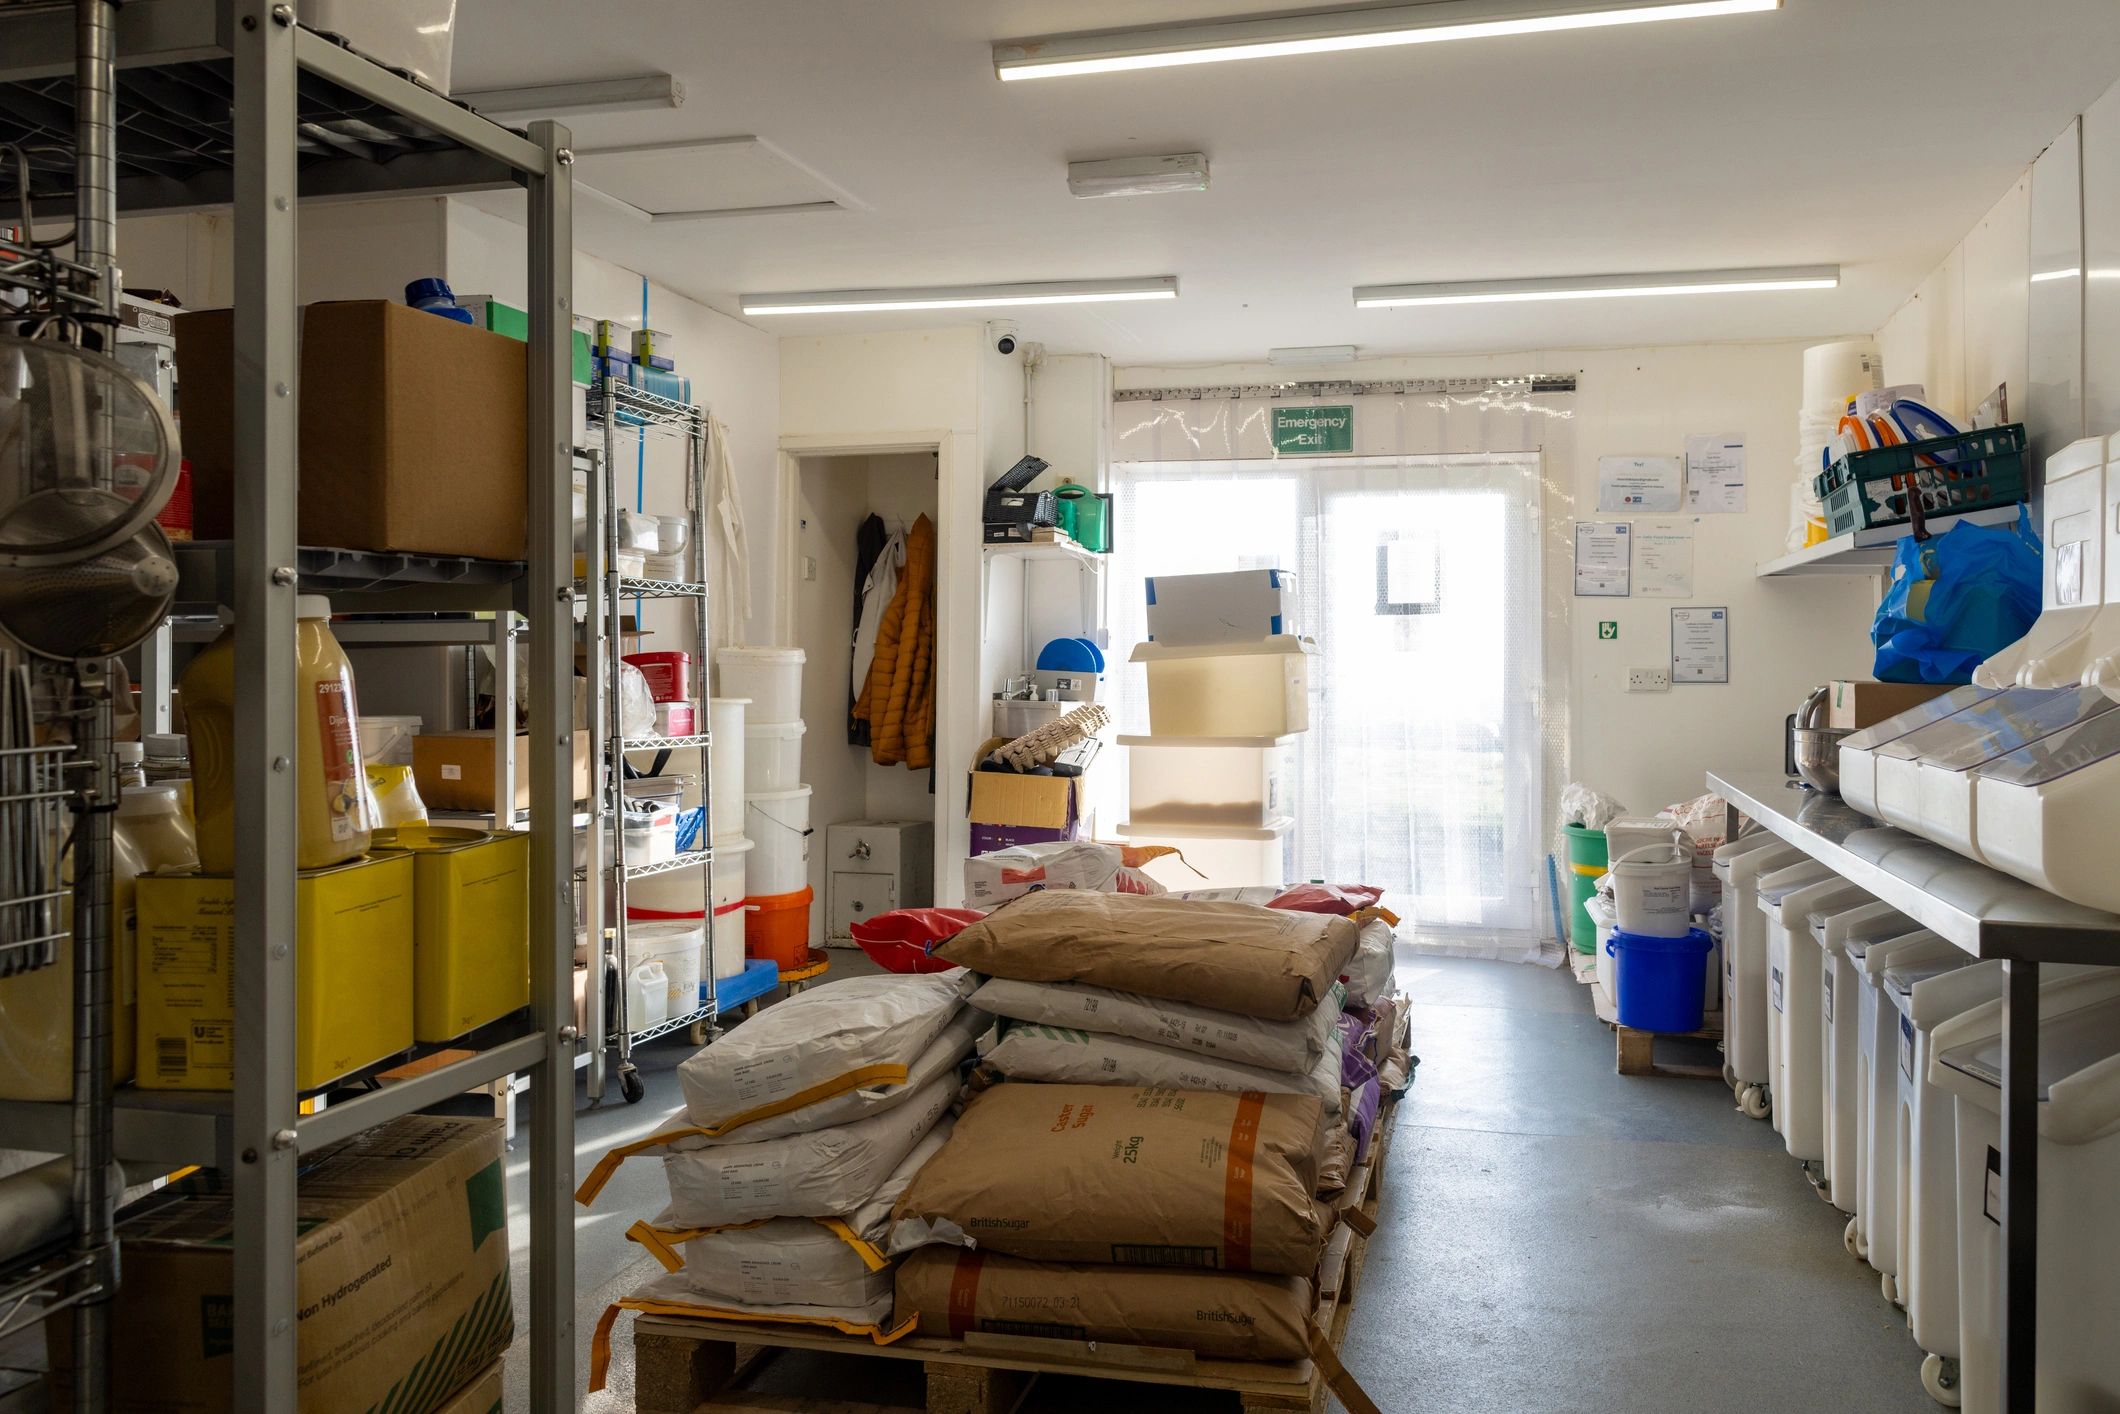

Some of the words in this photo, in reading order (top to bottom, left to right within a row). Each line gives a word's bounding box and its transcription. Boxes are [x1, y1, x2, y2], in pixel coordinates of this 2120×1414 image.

[1278, 416, 1346, 430] Emergency
[1298, 434, 1323, 445] Exit
[1051, 1103, 1073, 1132] Caster
[1071, 1103, 1095, 1129] Sugar
[1123, 1135, 1144, 1164] 25kg
[970, 1217, 1030, 1231] BritishSugar
[321, 1254, 392, 1308] Hydrogenated
[1196, 1310, 1256, 1327] BritishSugar
